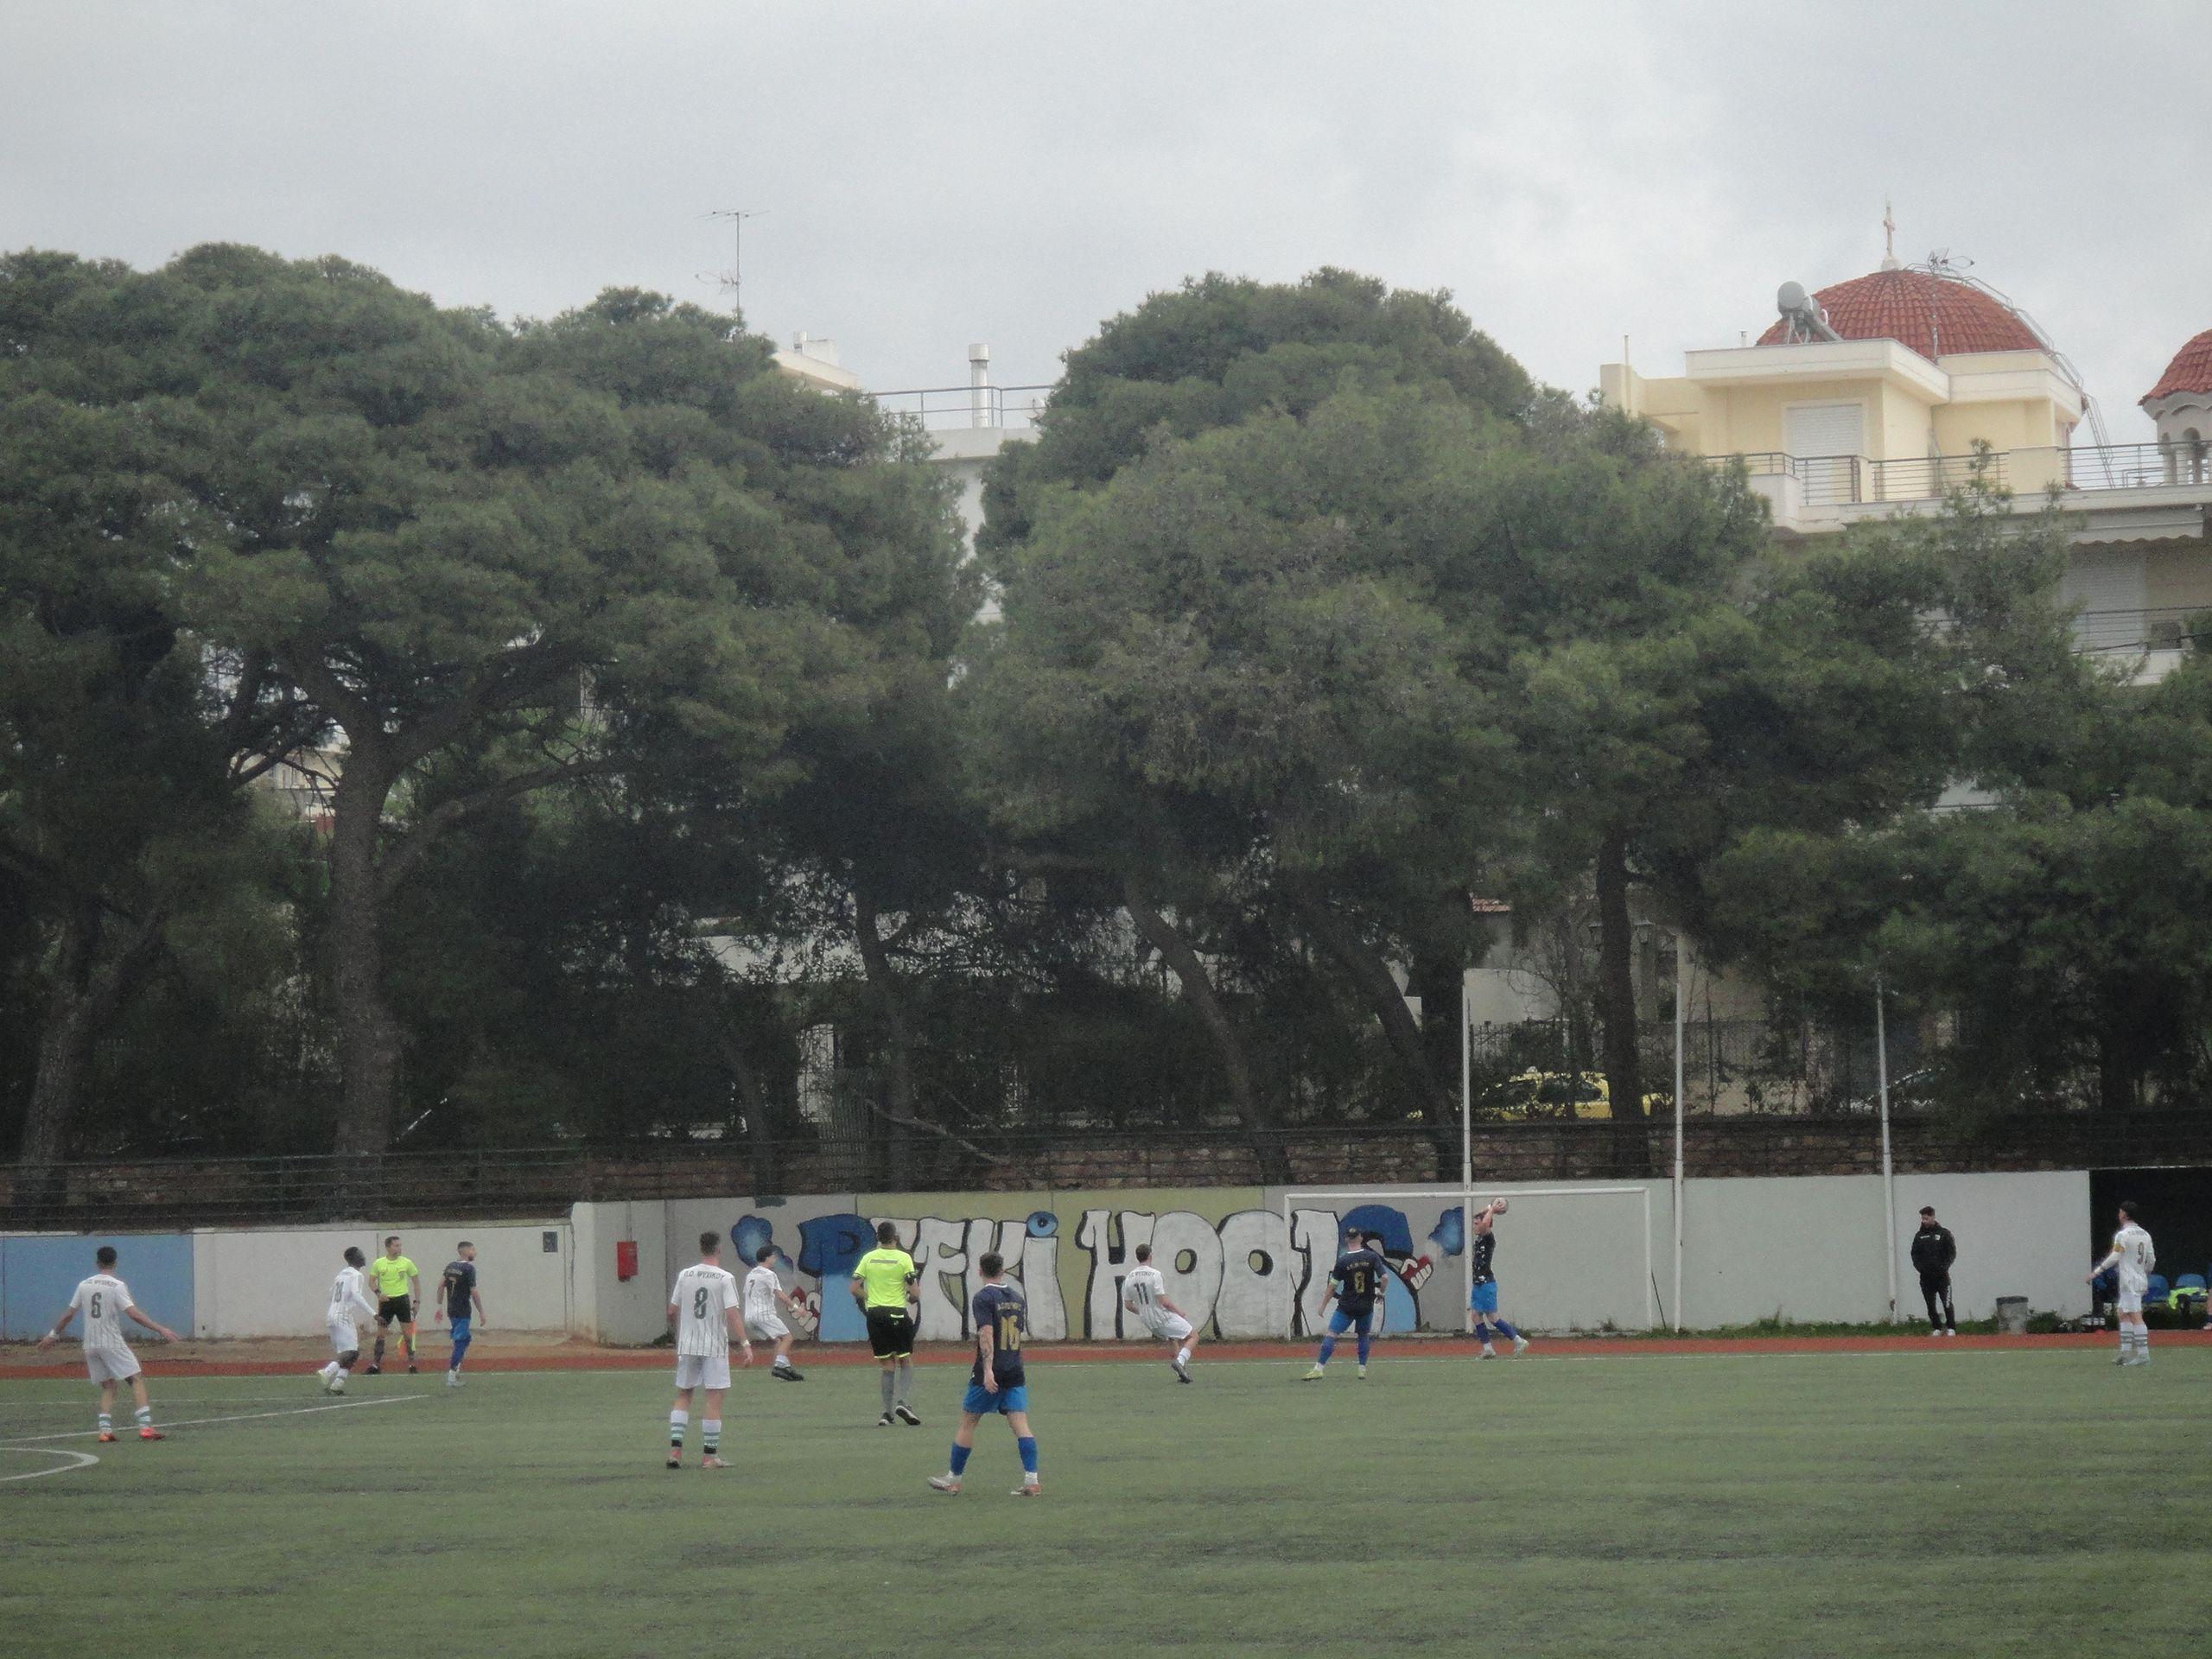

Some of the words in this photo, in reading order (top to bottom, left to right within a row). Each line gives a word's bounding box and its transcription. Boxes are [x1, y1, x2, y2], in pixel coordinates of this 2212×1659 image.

[91, 1292, 102, 1319] 6
[694, 1287, 708, 1319] 8
[1134, 1282, 1149, 1305] 11
[1001, 1315, 1020, 1351] 16
